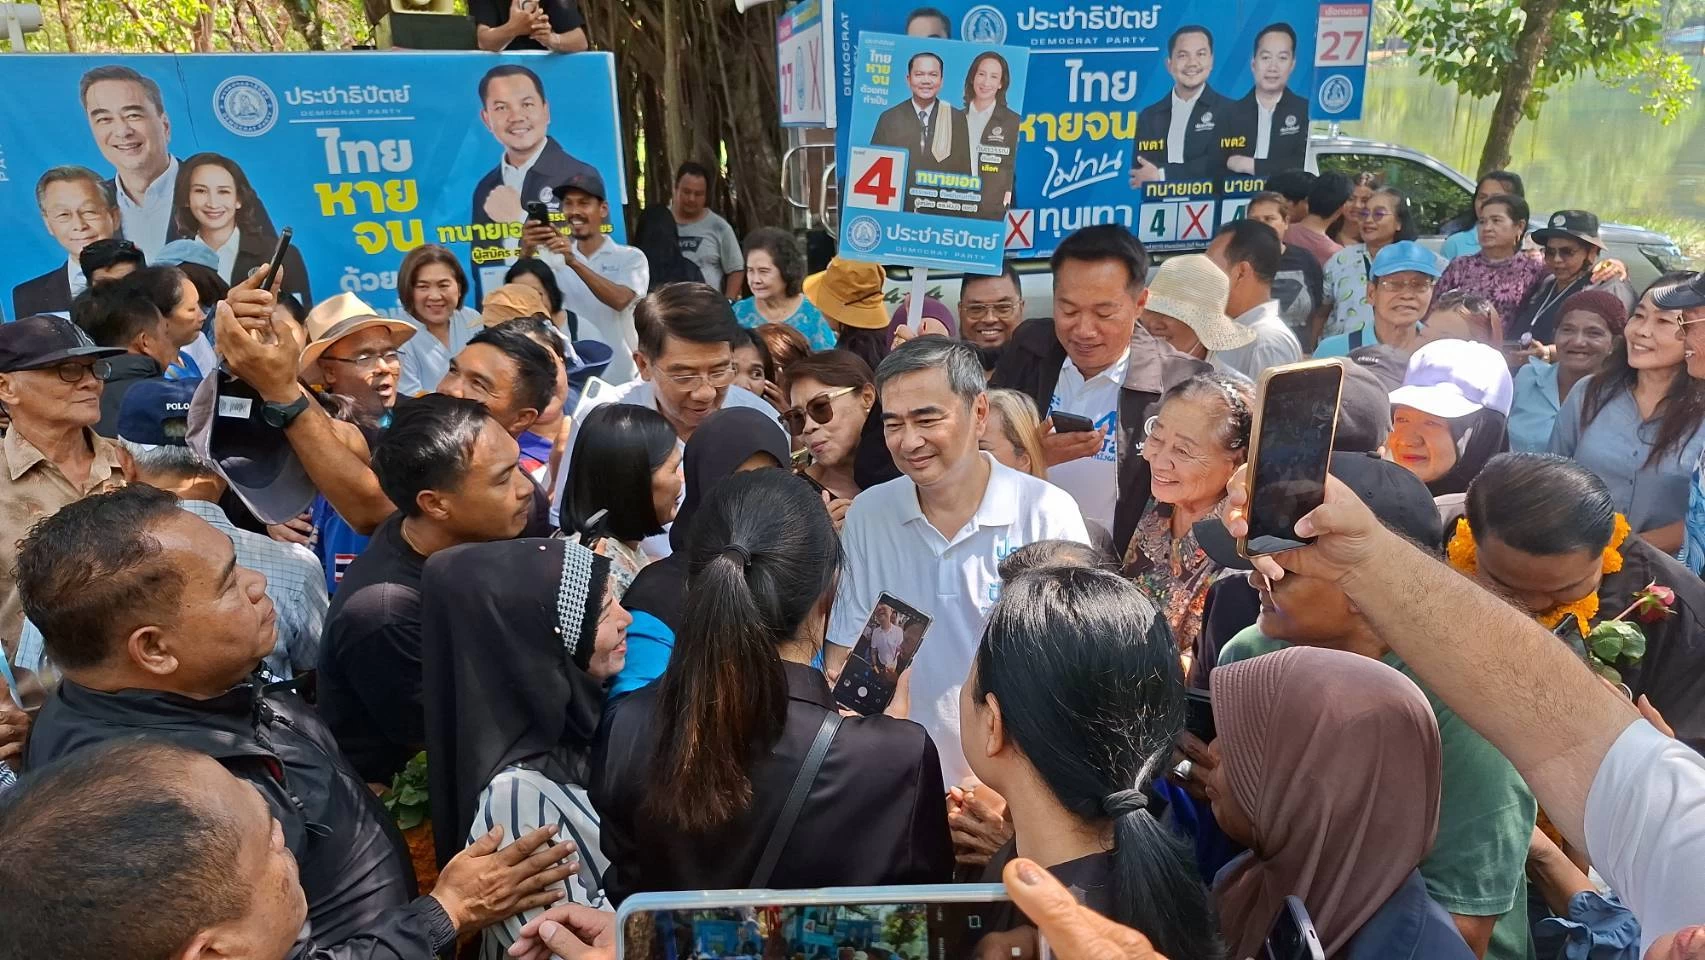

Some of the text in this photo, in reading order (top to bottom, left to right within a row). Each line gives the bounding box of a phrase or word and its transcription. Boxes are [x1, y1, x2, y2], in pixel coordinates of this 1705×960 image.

[1016, 5, 1162, 31] ประชาธิปัตย์
[1030, 36, 1147, 46] DEMOCRAT PARTY
[1320, 31, 1364, 60] 27
[841, 12, 852, 97] DEMOCRAT
[1064, 58, 1138, 103] ไทย
[285, 84, 411, 105] ประชาธิปัตย์
[316, 127, 413, 175] ไทย
[1138, 139, 1164, 151] เขต1
[1220, 136, 1246, 149] เขต2
[854, 156, 897, 205] 4
[916, 171, 980, 190] ทนายเอก
[1042, 146, 1123, 197] ไม่ทน
[313, 179, 419, 217] หาย
[1146, 180, 1214, 197] ทนายเอก
[1224, 178, 1266, 194] นายก
[437, 222, 524, 244] ทนายเอ
[1039, 204, 1133, 238] ทุนเทา
[1150, 209, 1166, 238] 4
[352, 218, 425, 255] จน
[886, 223, 1000, 251] ประชาธิปัตย์
[472, 247, 511, 263] ผู้สมัคร
[895, 245, 987, 261] DEMOCRAT PARTY
[166, 402, 190, 410] POLO
